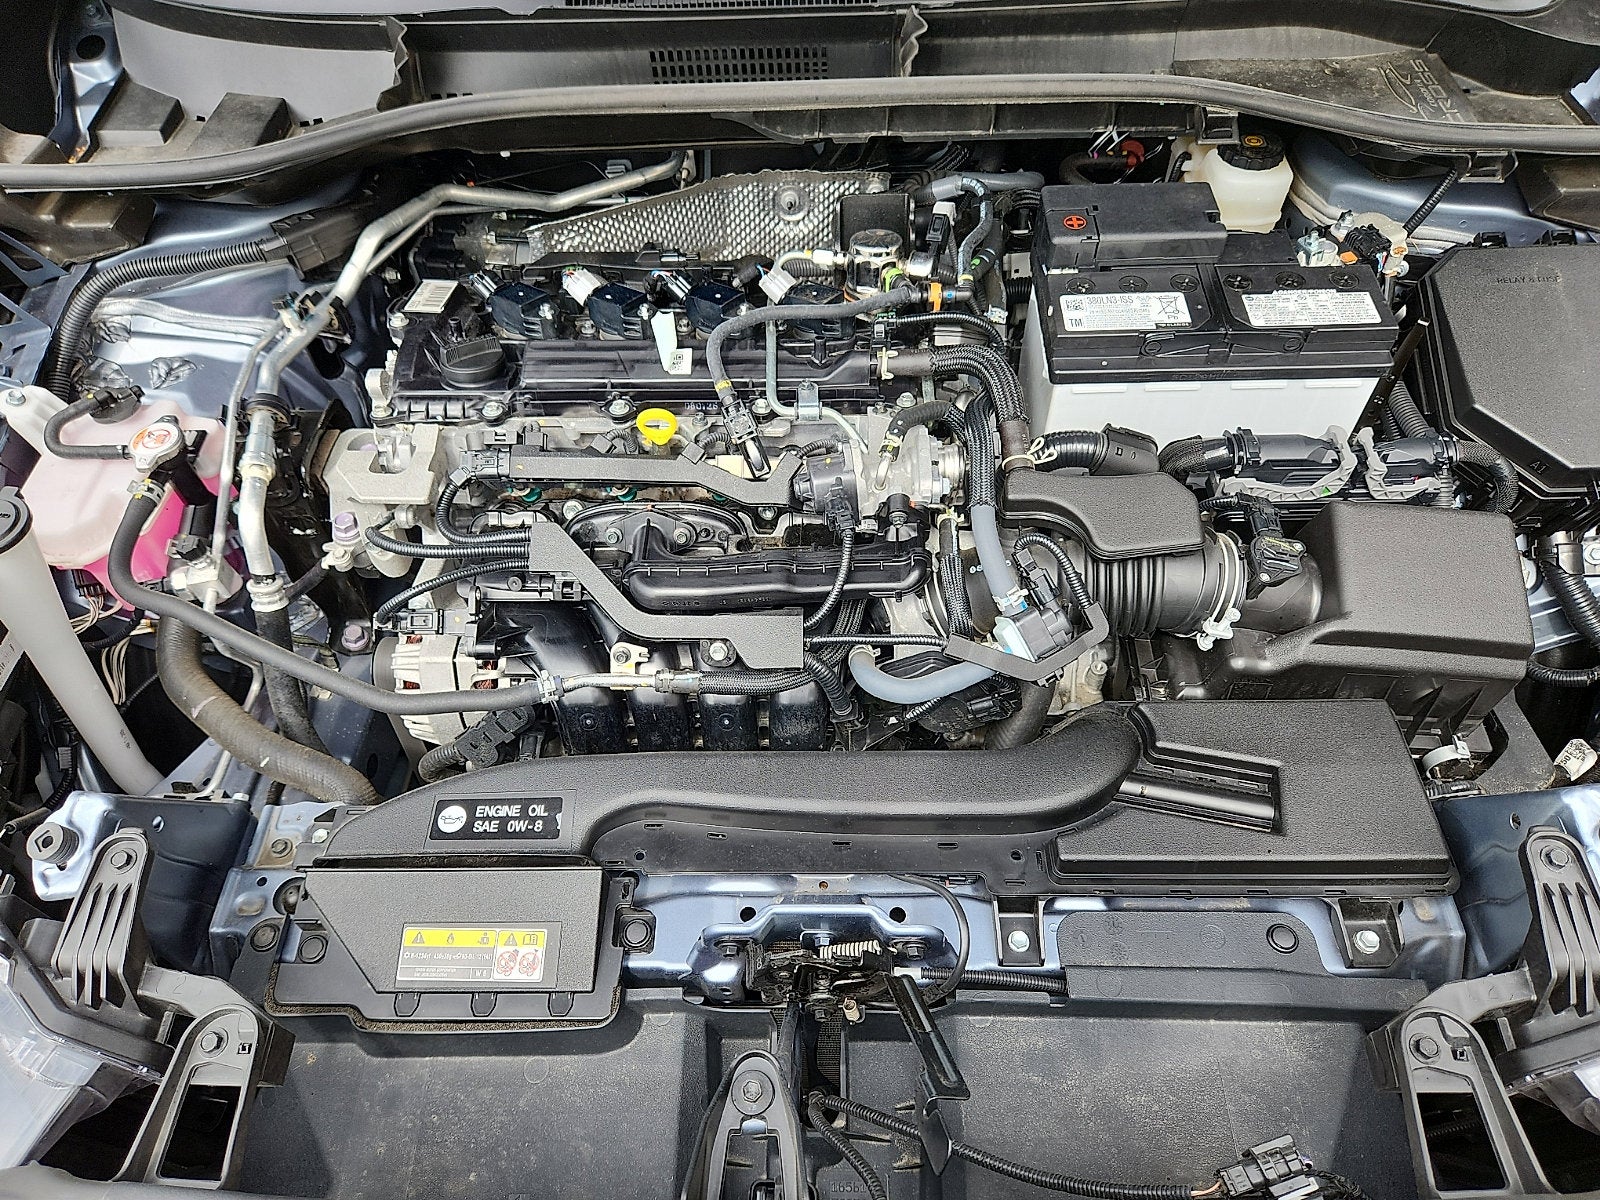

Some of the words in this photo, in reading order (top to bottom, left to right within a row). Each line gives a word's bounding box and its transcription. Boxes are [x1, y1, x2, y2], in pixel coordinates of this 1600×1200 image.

[1069, 319, 1083, 328] TM
[475, 805, 522, 818] ENGINE
[528, 804, 549, 817] OIL
[472, 820, 499, 832] SAE
[507, 820, 543, 832] 0W-8
